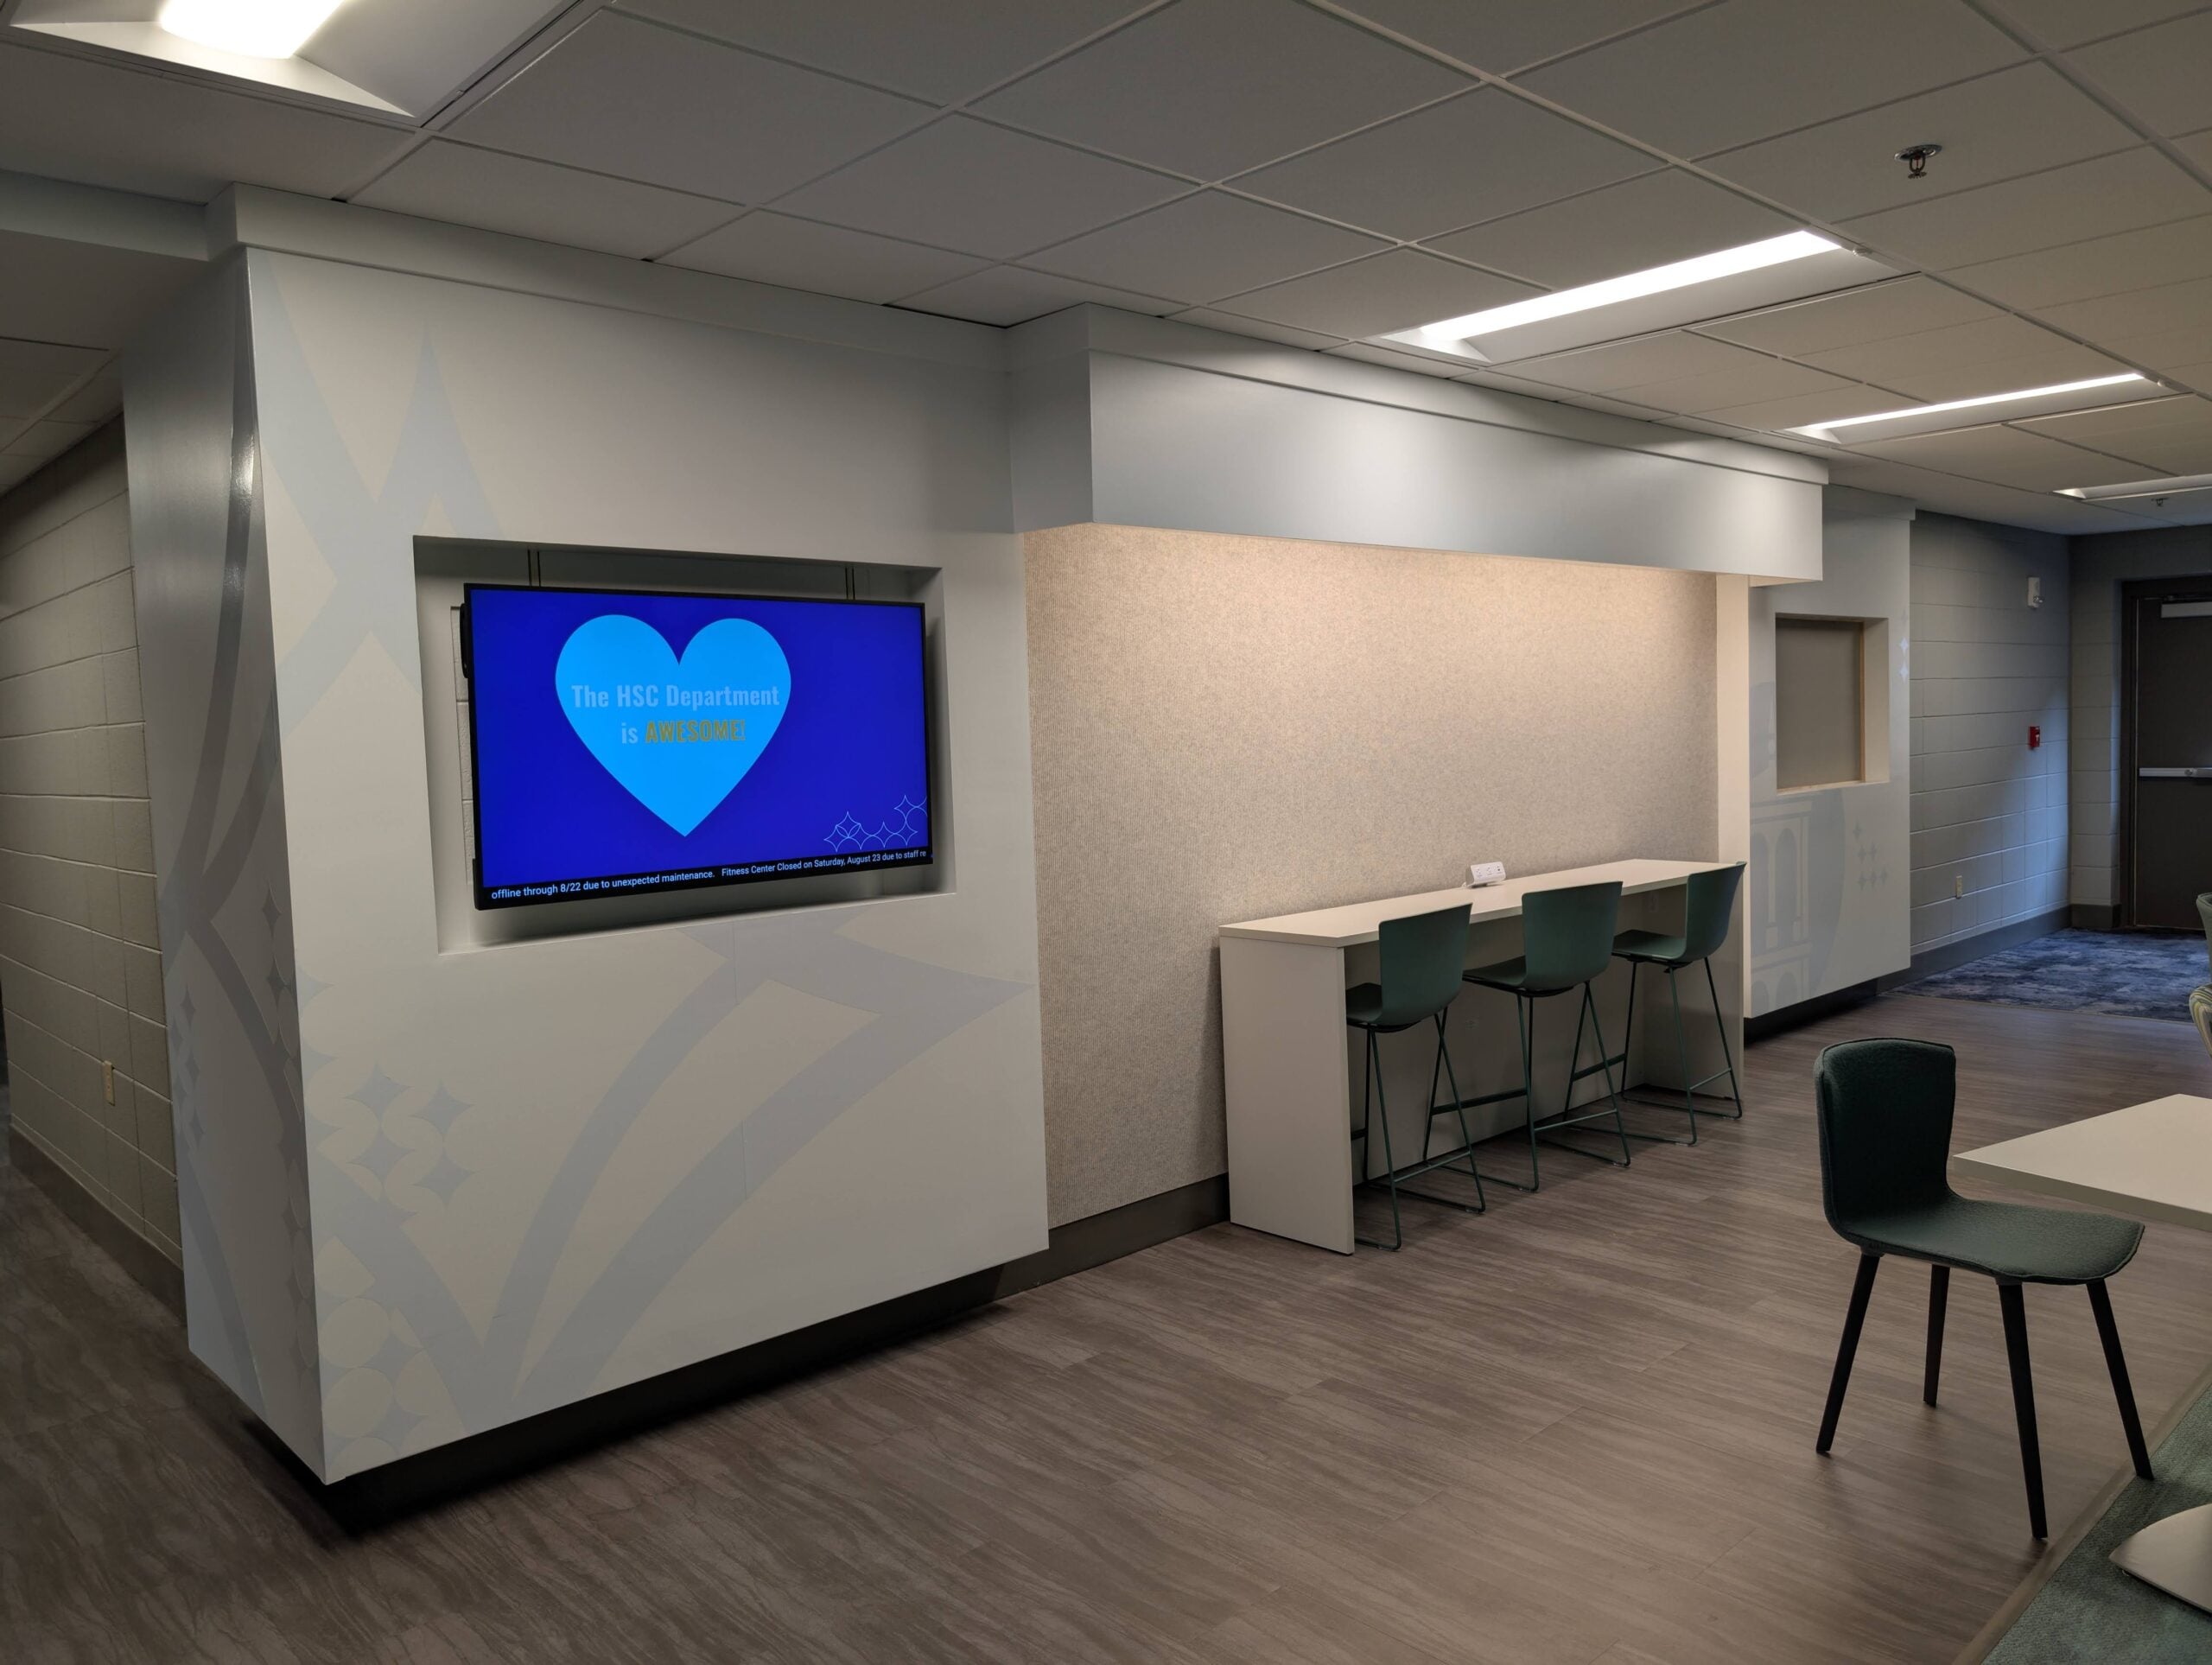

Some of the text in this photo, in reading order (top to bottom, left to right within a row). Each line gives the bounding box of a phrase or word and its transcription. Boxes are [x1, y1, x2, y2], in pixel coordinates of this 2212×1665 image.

[571, 684, 780, 711] The HSC Department
[621, 719, 746, 745] is AWESOME!
[491, 888, 521, 899] offline
[524, 884, 558, 896] through
[560, 882, 581, 893] 8/22
[582, 880, 599, 891] due
[601, 880, 610, 889] to
[612, 874, 660, 887] unexpected
[662, 872, 715, 882] maintenance.
[721, 867, 749, 877] Fitness
[751, 865, 775, 874] Center
[777, 861, 802, 871] Closed
[814, 857, 846, 867] Saturday,
[847, 855, 871, 865] August
[872, 853, 881, 862] 23
[881, 852, 894, 861] due
[903, 849, 918, 858] staff
